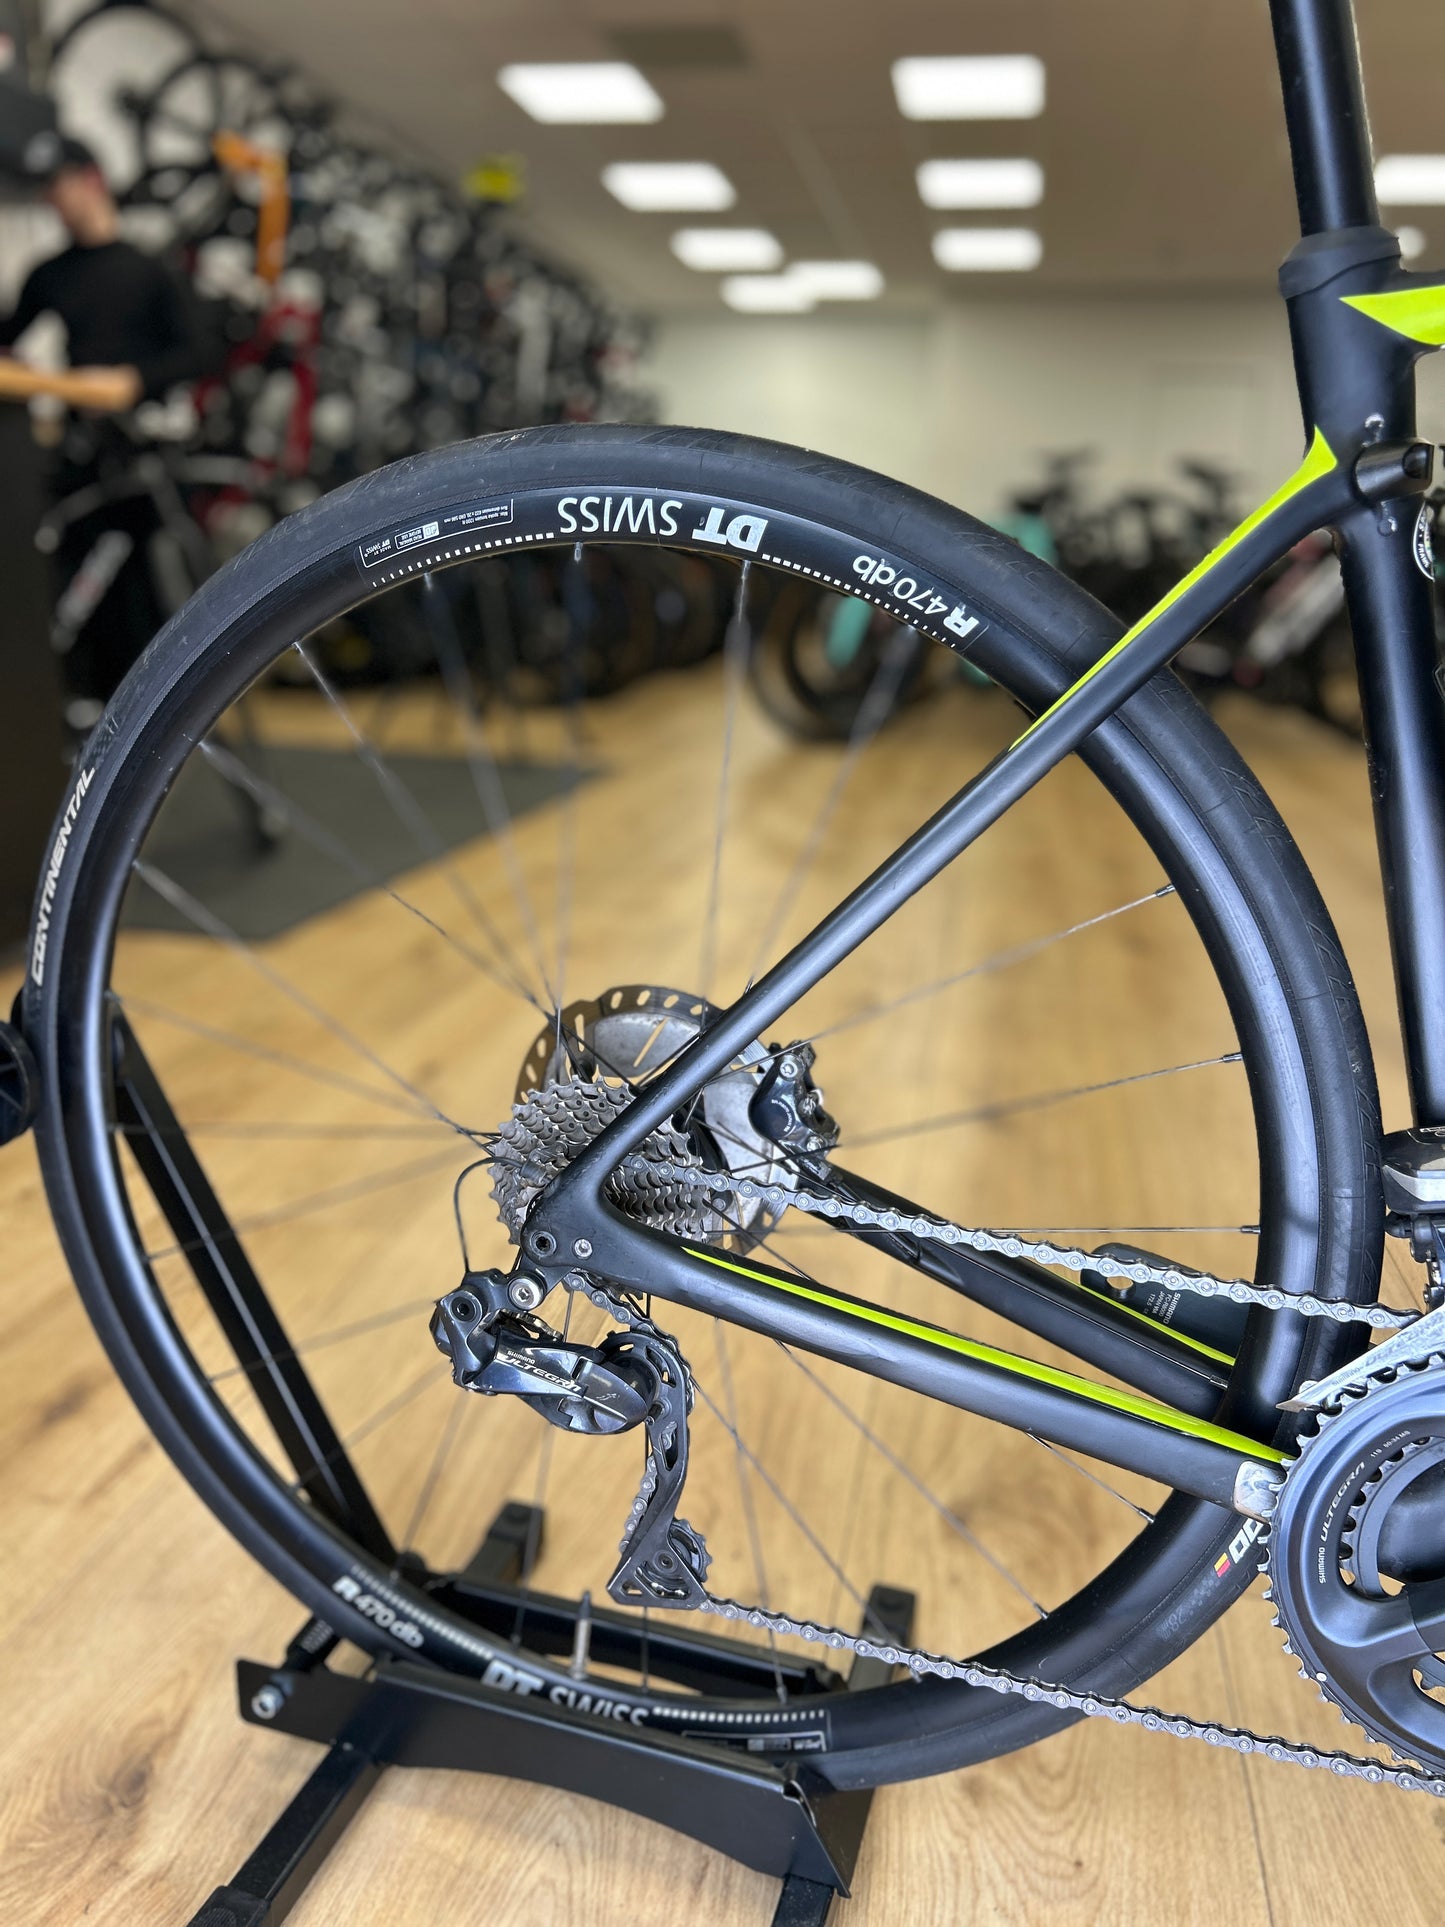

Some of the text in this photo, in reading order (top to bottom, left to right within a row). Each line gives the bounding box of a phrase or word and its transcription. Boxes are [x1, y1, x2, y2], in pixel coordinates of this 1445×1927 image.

[557, 496, 769, 553] DT SWISS
[31, 767, 95, 986] CONTINENTAL
[1162, 1292, 1181, 1324] SHIMANO
[507, 1350, 536, 1364] SHIMANO
[1320, 1461, 1366, 1542] ULTEGRA
[1318, 1547, 1326, 1584] SHIMANO
[480, 1659, 545, 1697] DT
